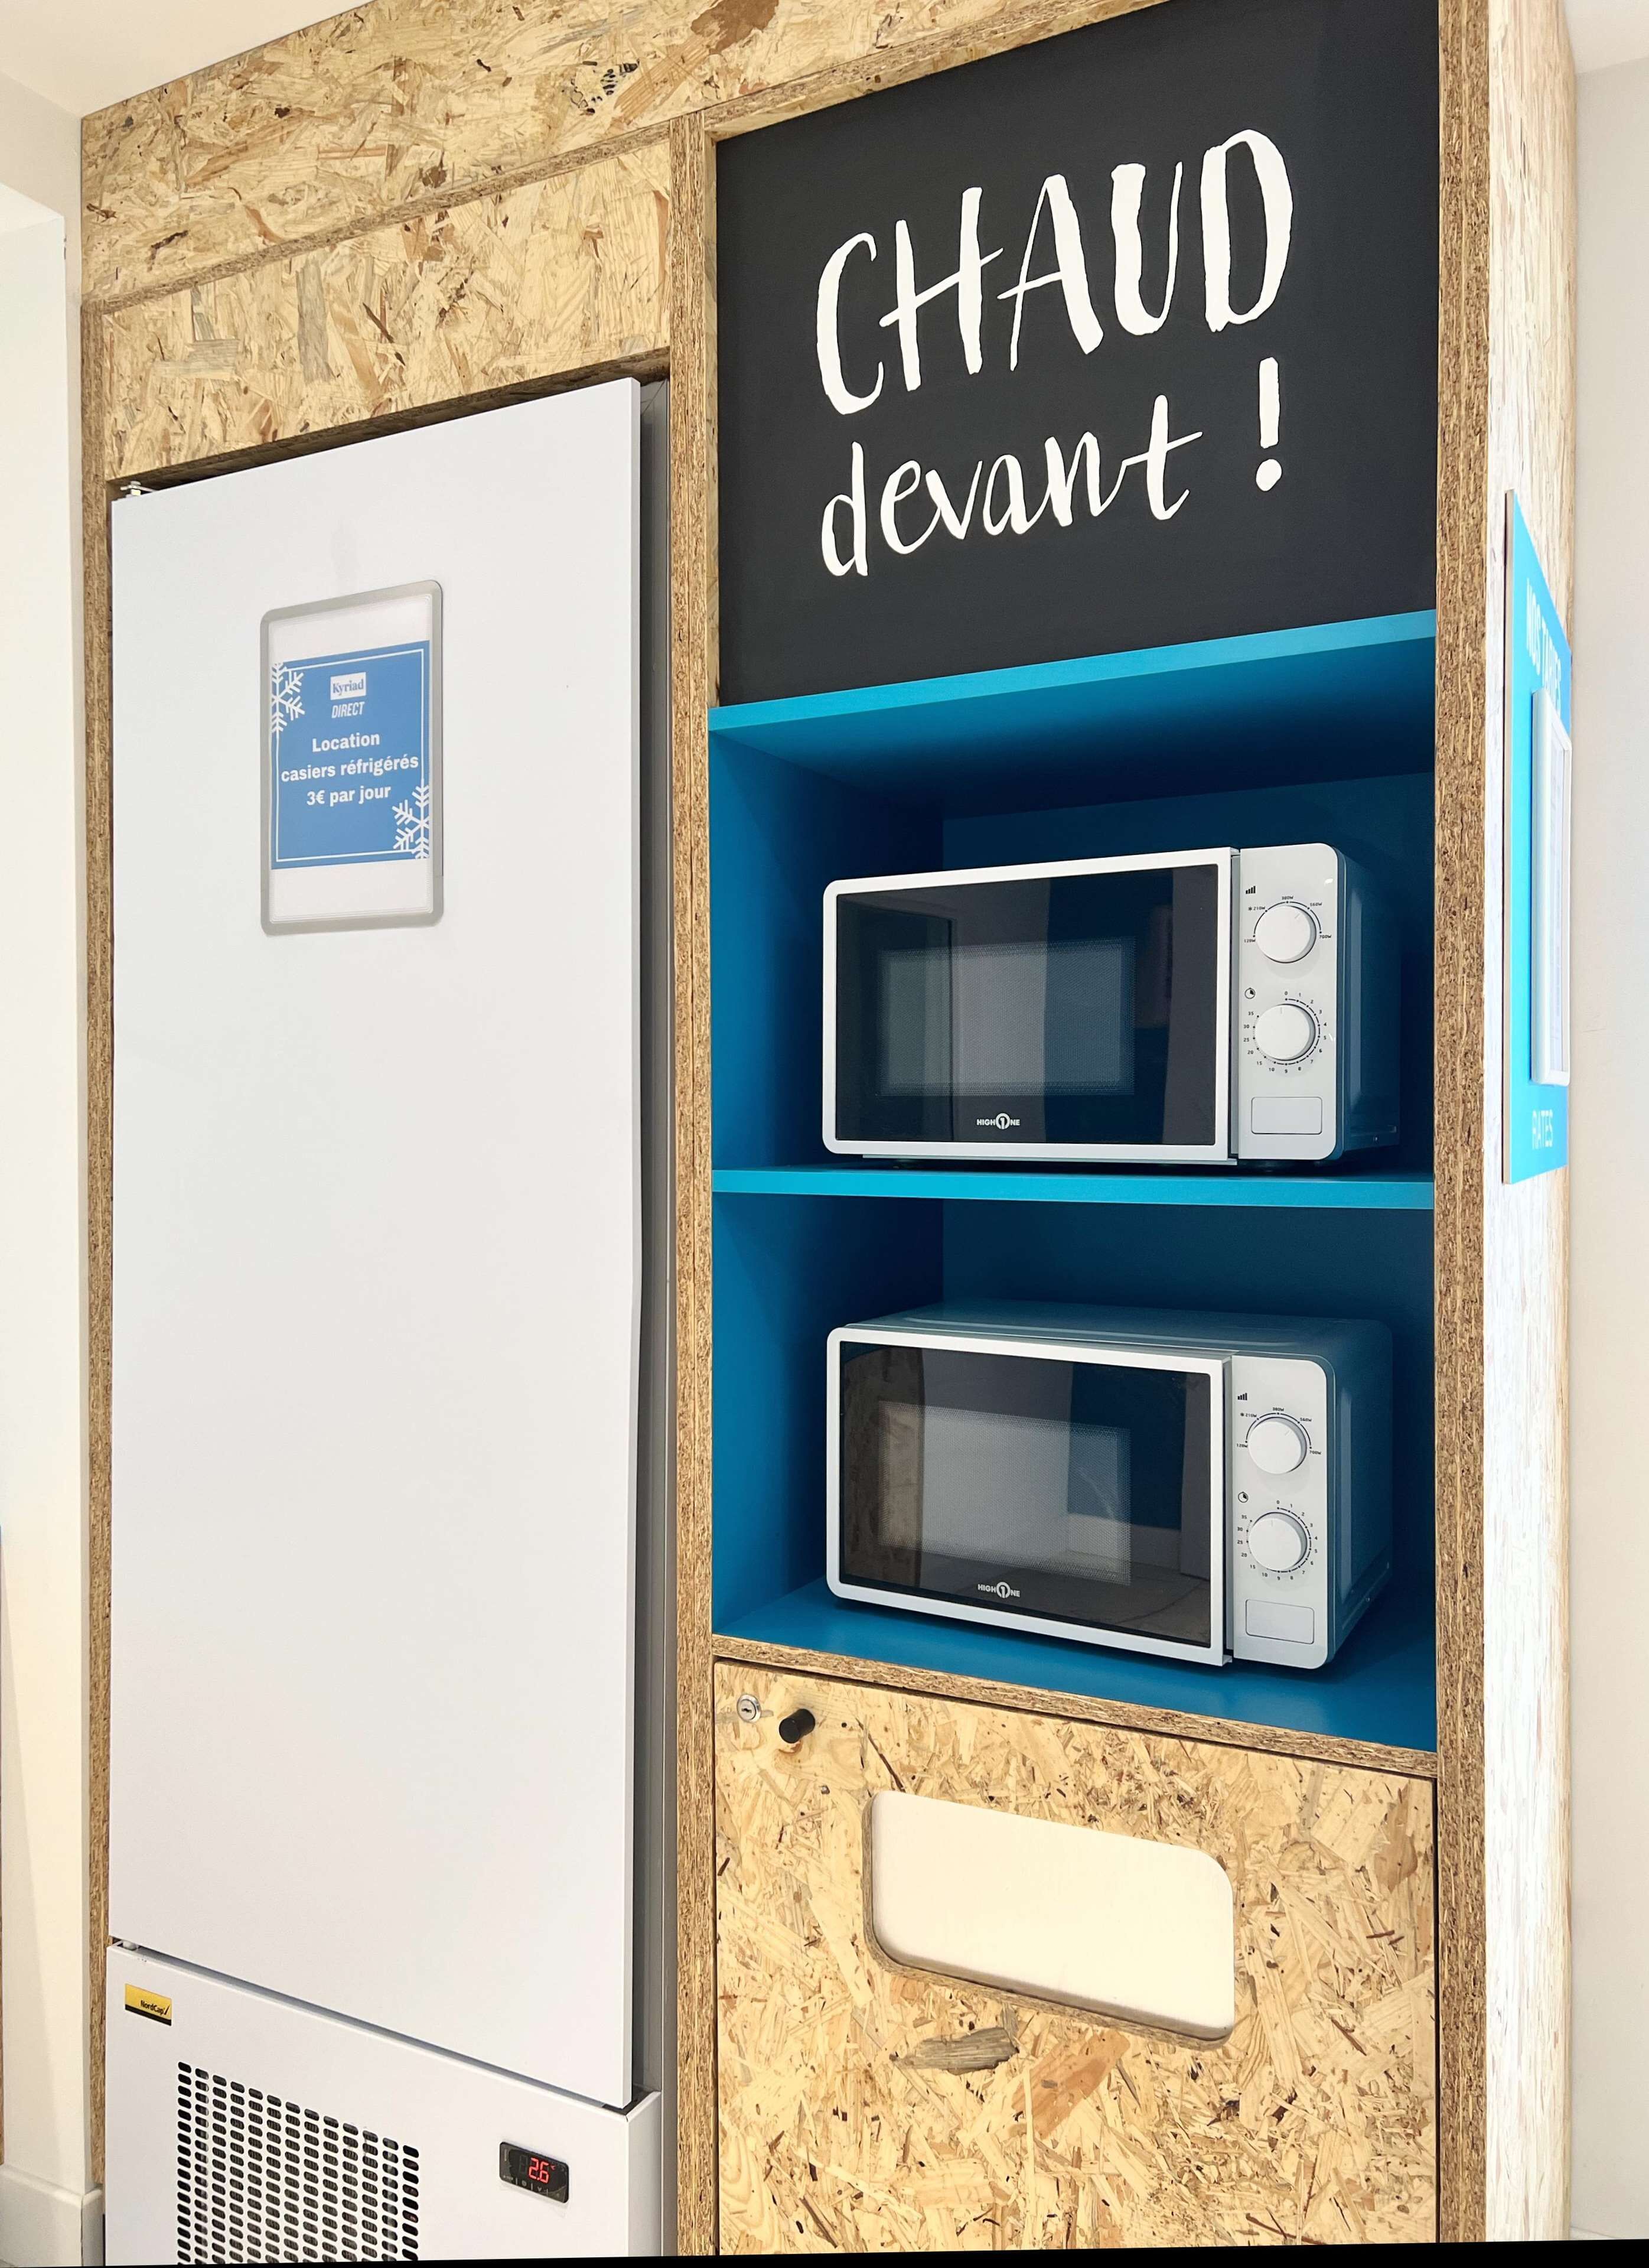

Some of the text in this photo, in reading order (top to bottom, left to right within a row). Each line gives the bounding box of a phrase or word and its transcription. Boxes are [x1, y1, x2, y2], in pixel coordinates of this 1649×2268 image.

[816, 129, 1293, 415] CHAUD
[822, 357, 1282, 577] devant !
[333, 679, 364, 696] Kyriad
[331, 701, 365, 718] DIRECT
[312, 732, 380, 753] Location
[281, 754, 419, 782] casiers réfrigérés
[307, 785, 391, 808] 3€ par jour
[1532, 1109, 1553, 1149] RATES
[529, 2158, 549, 2184] 2.6
